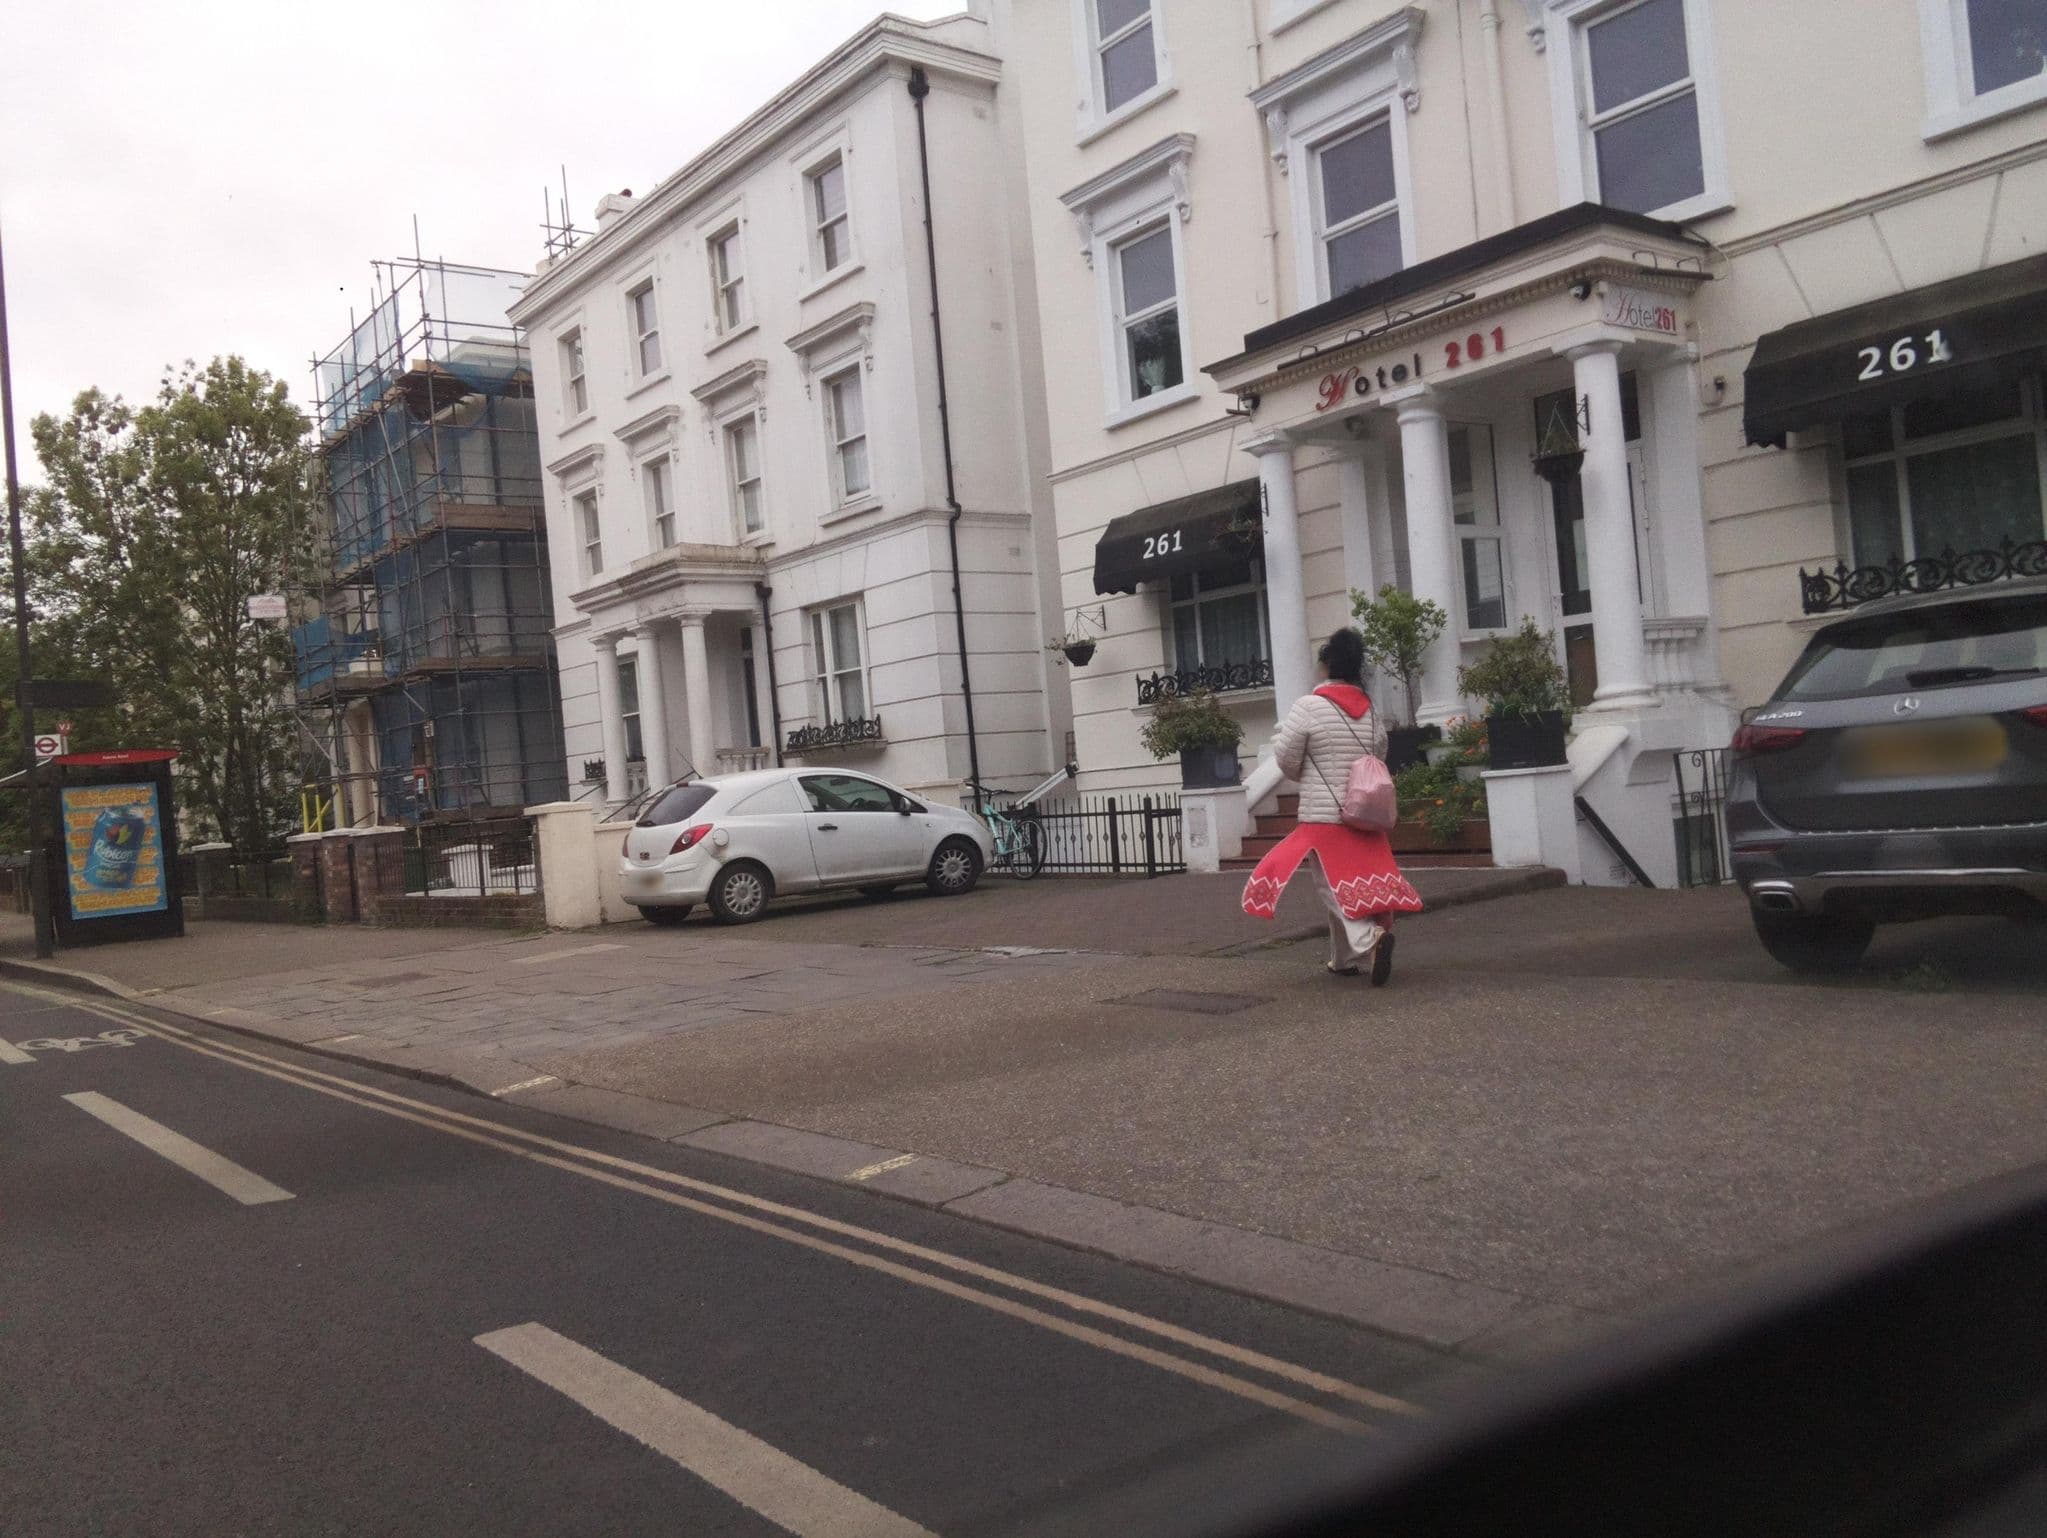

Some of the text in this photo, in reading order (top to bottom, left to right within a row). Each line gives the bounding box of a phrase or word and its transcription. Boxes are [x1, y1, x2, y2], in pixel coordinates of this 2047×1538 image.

[1315, 326, 1505, 411] Hotel 261
[1857, 329, 1951, 381] 261
[1142, 530, 1183, 560] 261
[95, 839, 134, 862] Rubicon
